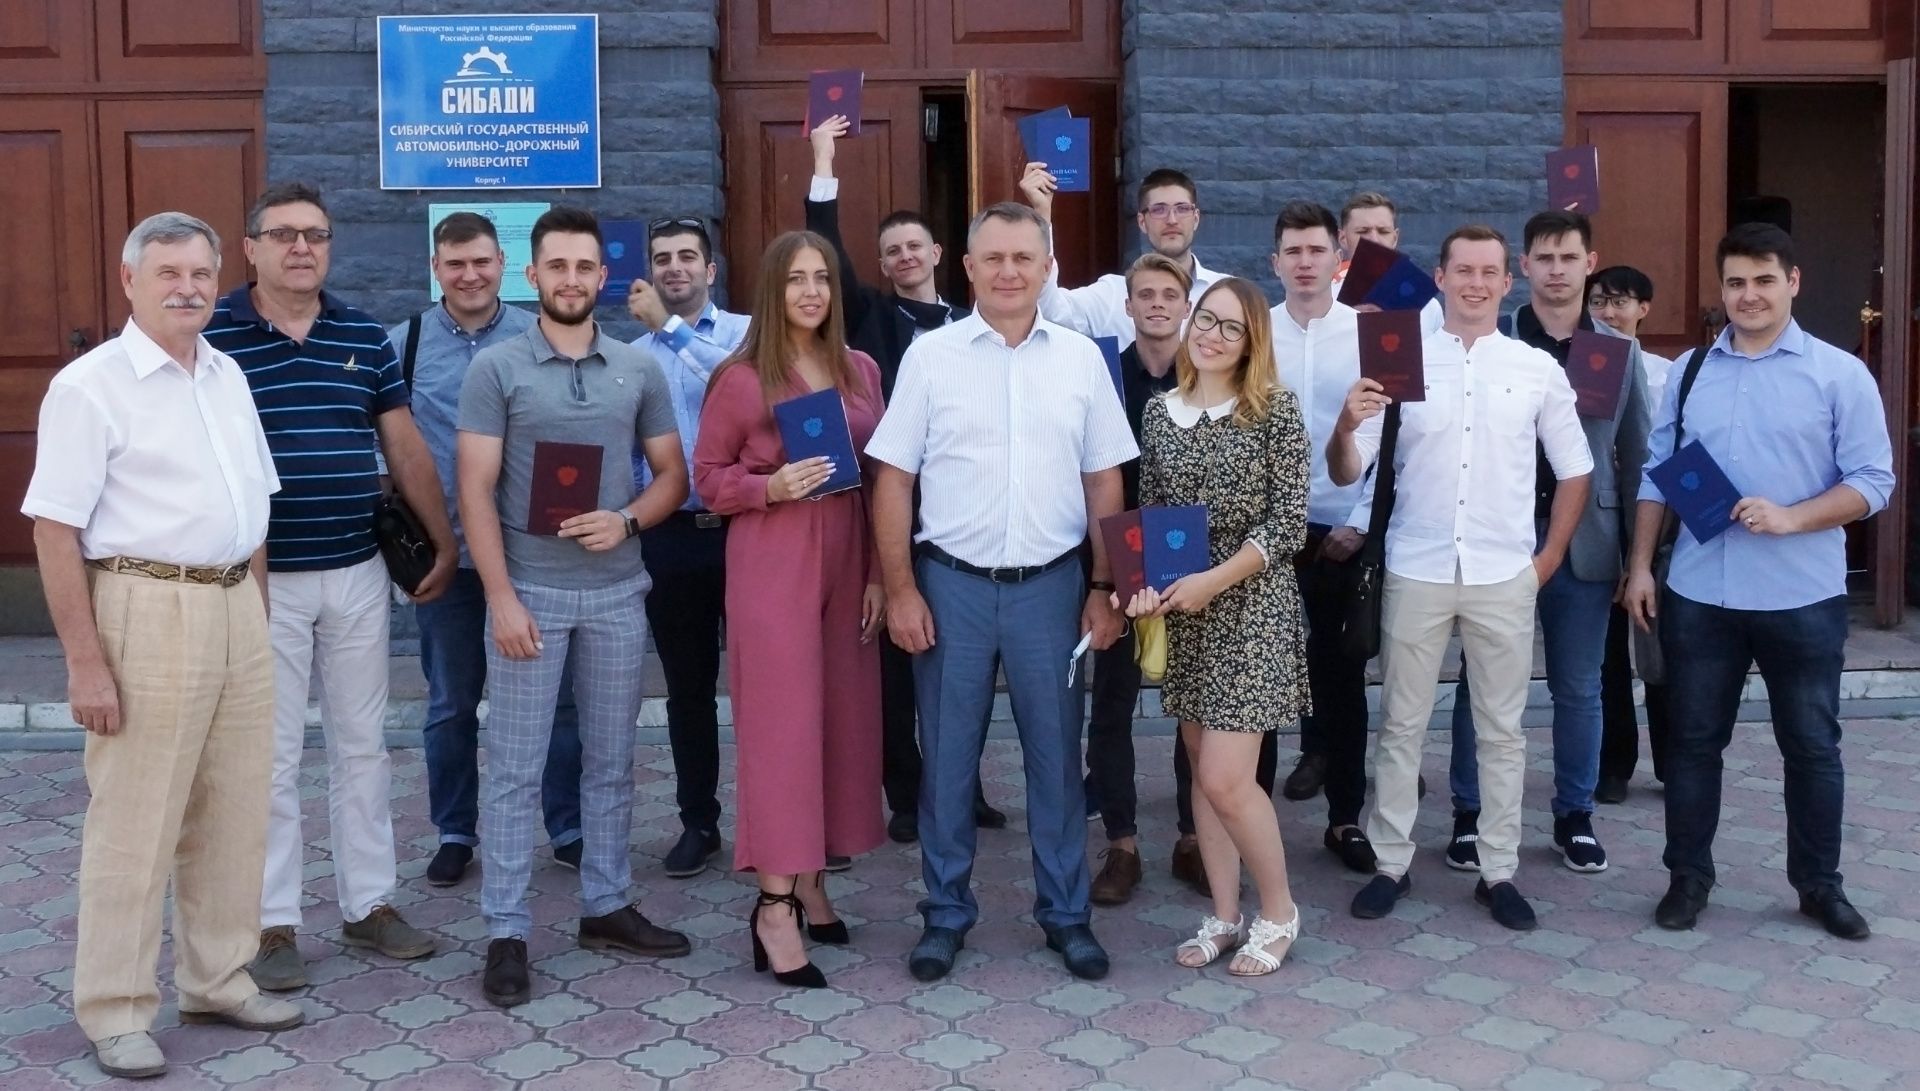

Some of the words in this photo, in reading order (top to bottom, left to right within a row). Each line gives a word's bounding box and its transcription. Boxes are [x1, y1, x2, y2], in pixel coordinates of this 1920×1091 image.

[398, 24, 454, 33] Министерство
[456, 25, 480, 33] науки
[489, 25, 524, 33] высшего
[526, 23, 577, 32] образования
[440, 34, 485, 42] Российской
[487, 34, 533, 43] Федерации
[441, 86, 535, 114] СИБАДИ
[389, 123, 464, 136] СИБИРСКИЙ
[467, 121, 589, 136] ГОСУДАРСТВЕННЫЙ
[395, 138, 580, 153] АВТОМОБИЛЬНО-ДОРОЖНЫЙ
[446, 156, 530, 168] УНИВЕРСИТЕТ
[474, 176, 501, 185] Корпус
[1571, 835, 1597, 846] PUMA
